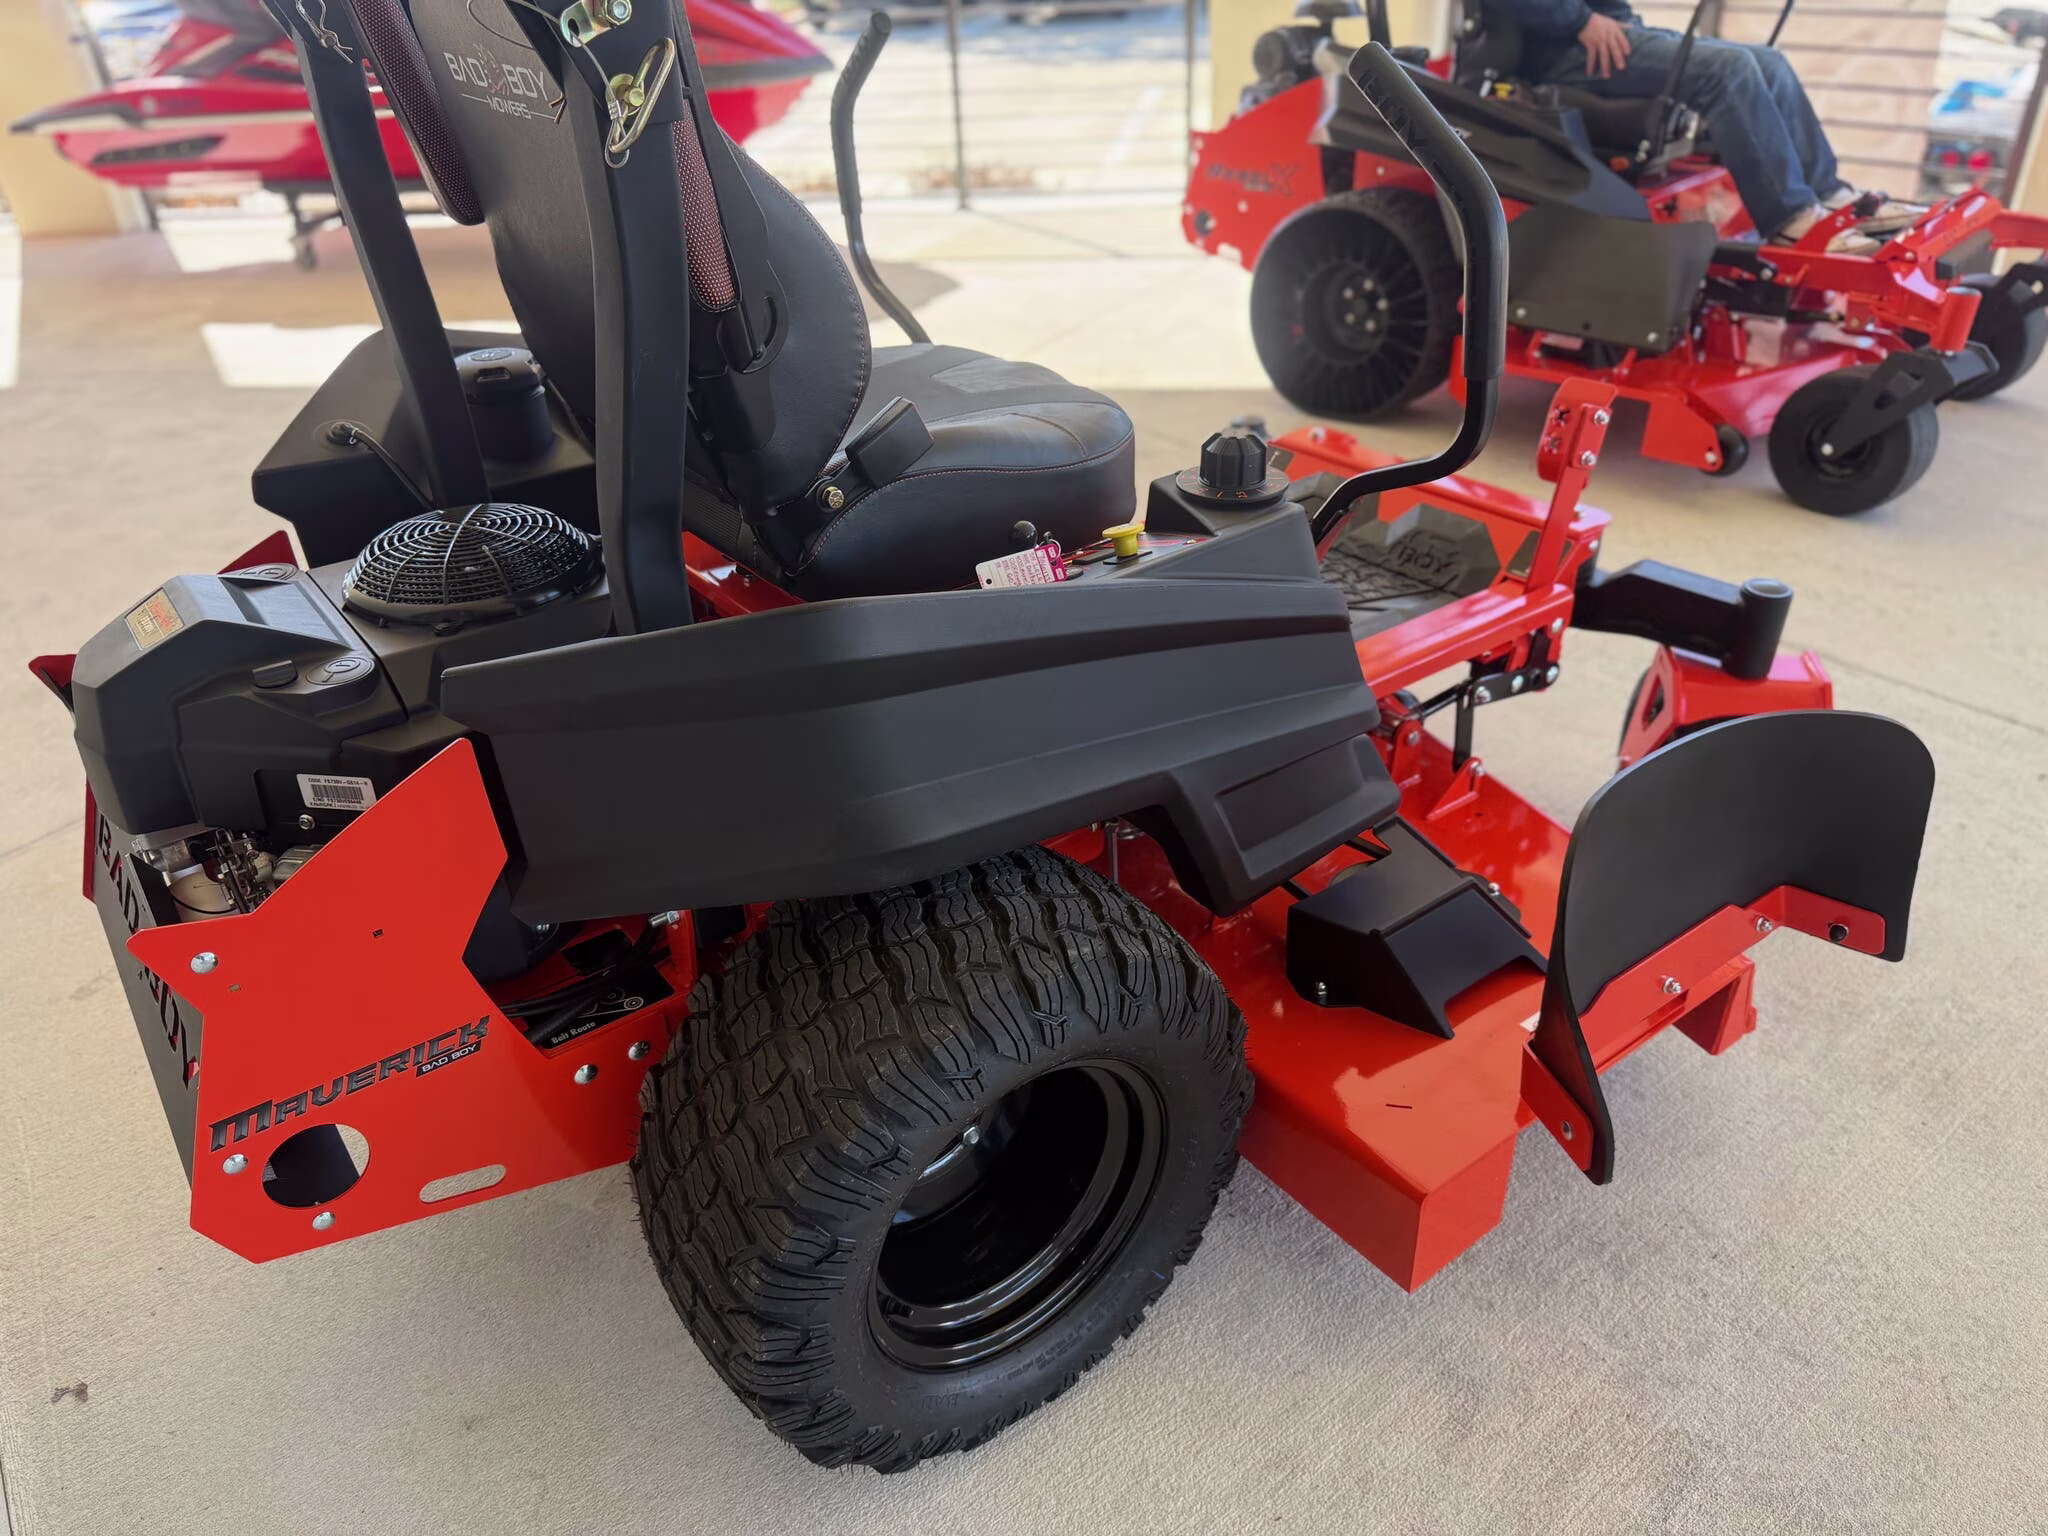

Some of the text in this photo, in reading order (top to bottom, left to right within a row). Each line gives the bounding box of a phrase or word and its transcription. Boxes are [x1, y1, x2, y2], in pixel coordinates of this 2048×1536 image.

[443, 52, 549, 101] BAD BOY
[486, 95, 532, 120] MOWERS
[551, 1021, 597, 1044] Belt Route
[421, 1043, 478, 1073] BAD BOY
[208, 1015, 490, 1152] MAVERICK
